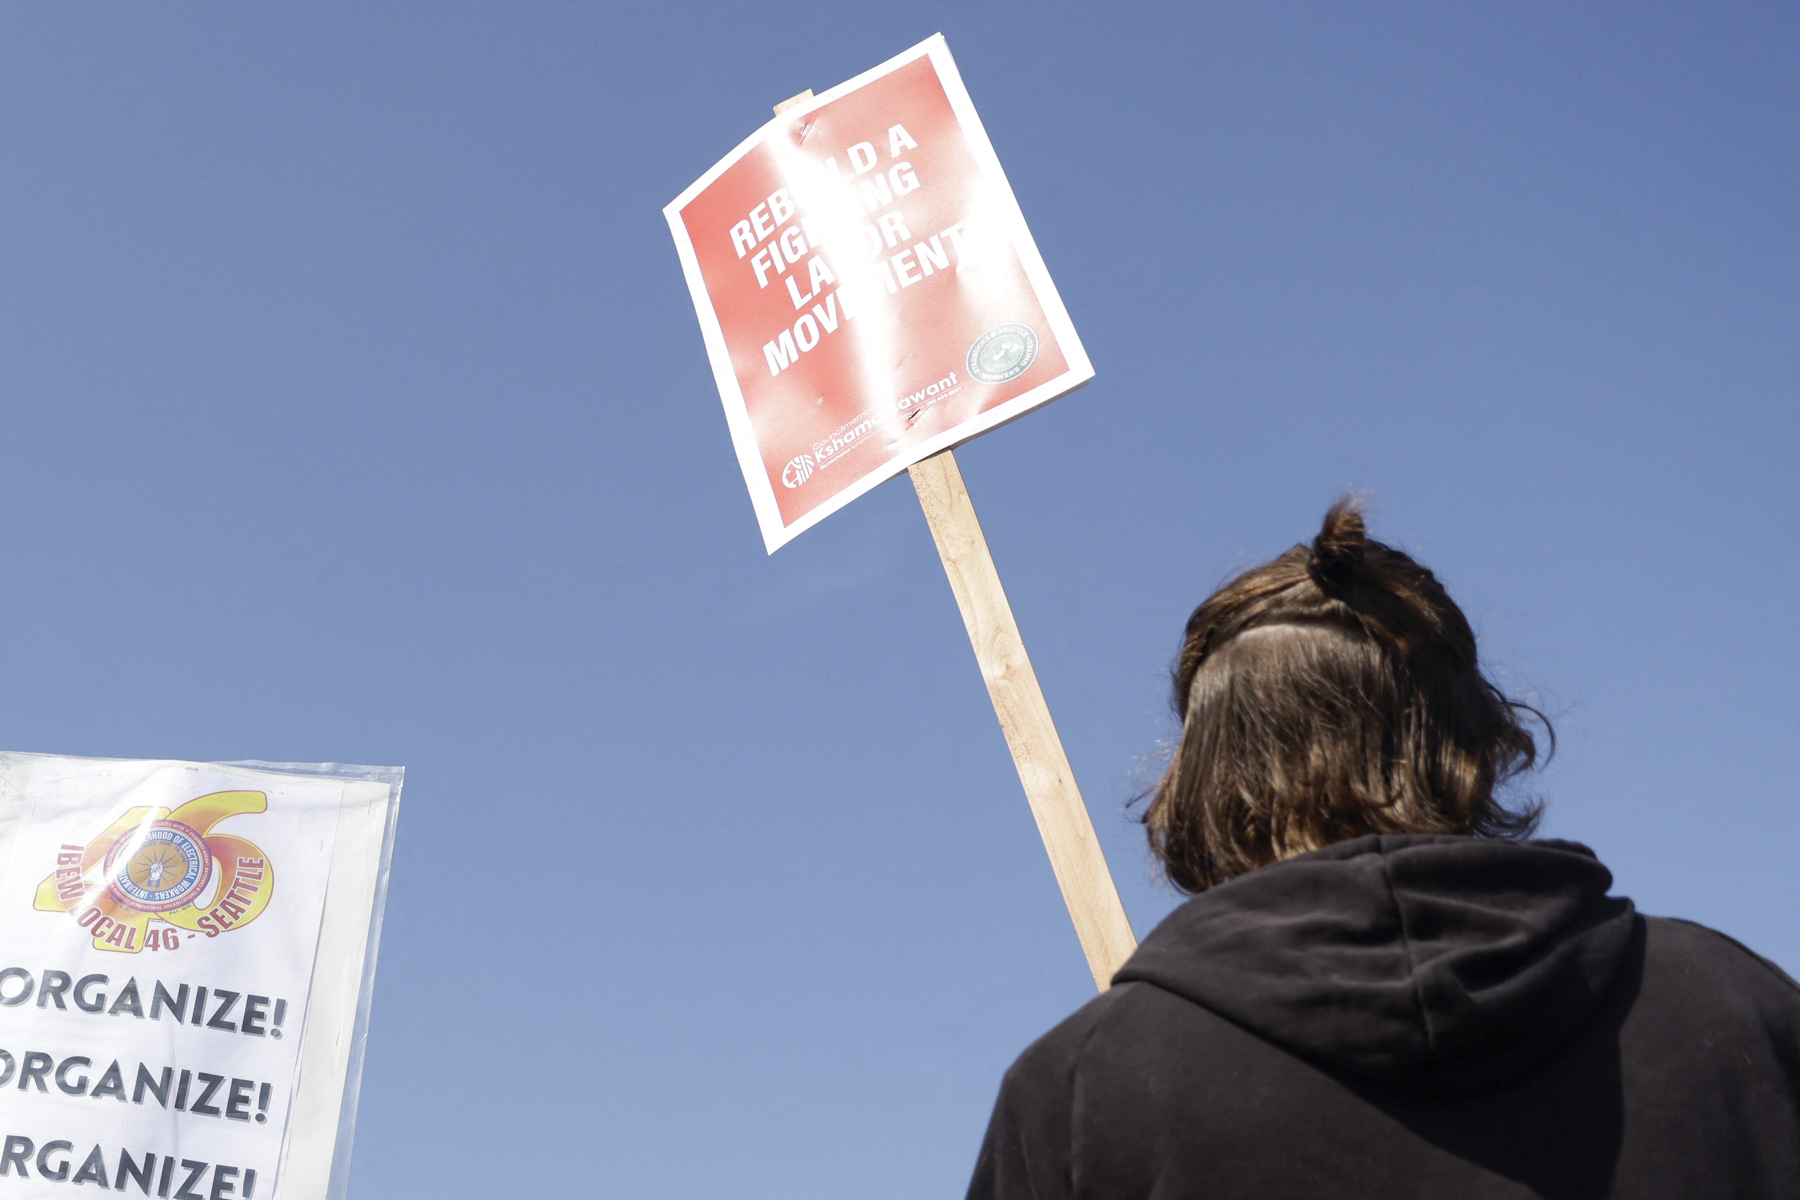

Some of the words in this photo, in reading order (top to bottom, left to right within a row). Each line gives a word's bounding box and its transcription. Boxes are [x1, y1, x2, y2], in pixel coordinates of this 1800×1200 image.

[729, 140, 878, 260] REBLD
[887, 122, 918, 158] A
[750, 160, 921, 289] FIGNG
[762, 221, 969, 378] MOVENT
[785, 210, 911, 310] LAOR
[812, 406, 876, 451] Councilmemb
[154, 878, 191, 900] WORKERS
[173, 834, 185, 845] OF
[181, 841, 198, 880] ELECTRICAL
[54, 844, 86, 901] IBEW
[144, 927, 180, 951] 46
[197, 857, 265, 938] SEATTLE
